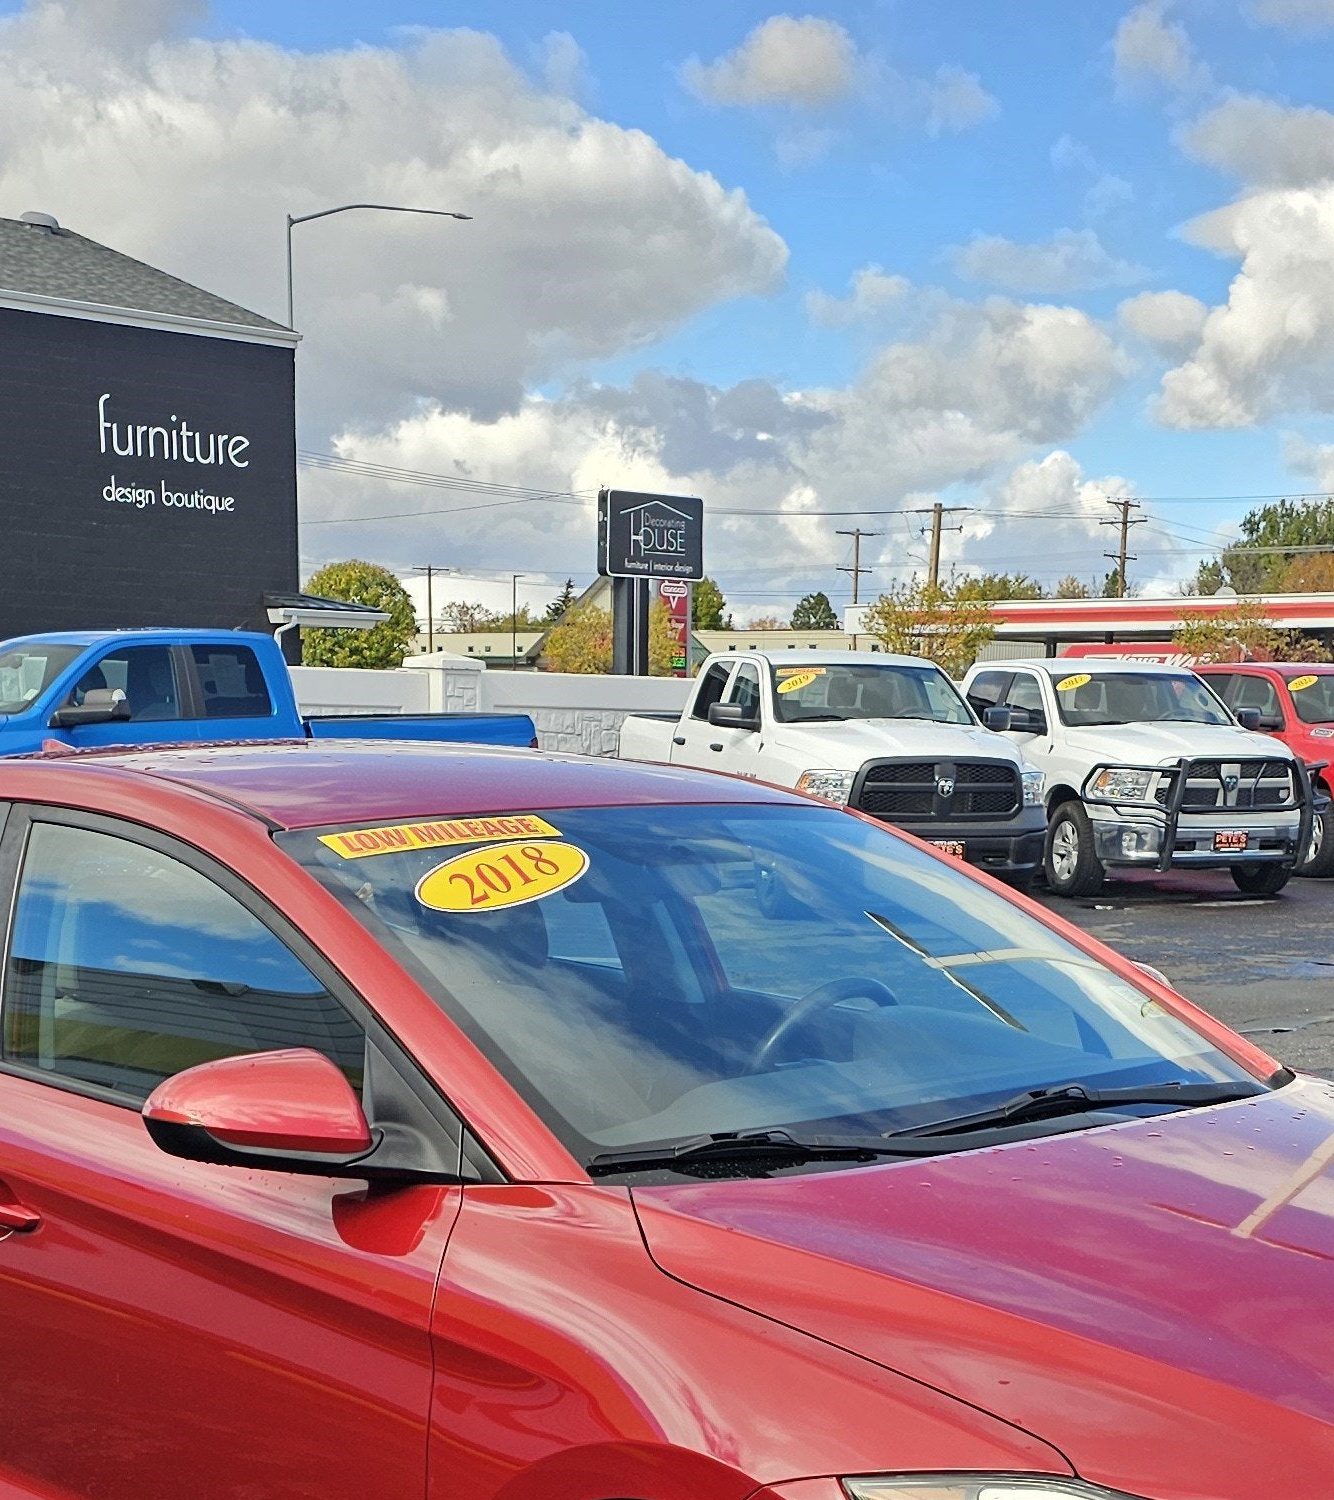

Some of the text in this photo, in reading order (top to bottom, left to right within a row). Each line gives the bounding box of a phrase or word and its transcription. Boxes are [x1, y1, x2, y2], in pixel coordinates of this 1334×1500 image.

[98, 393, 250, 468] furniture
[102, 475, 235, 514] design boutique
[644, 512, 686, 530] Decorating
[674, 561, 694, 574] design
[786, 675, 809, 690] 2019
[338, 817, 544, 853] LOW MILEAGE
[449, 846, 560, 906] 2018
